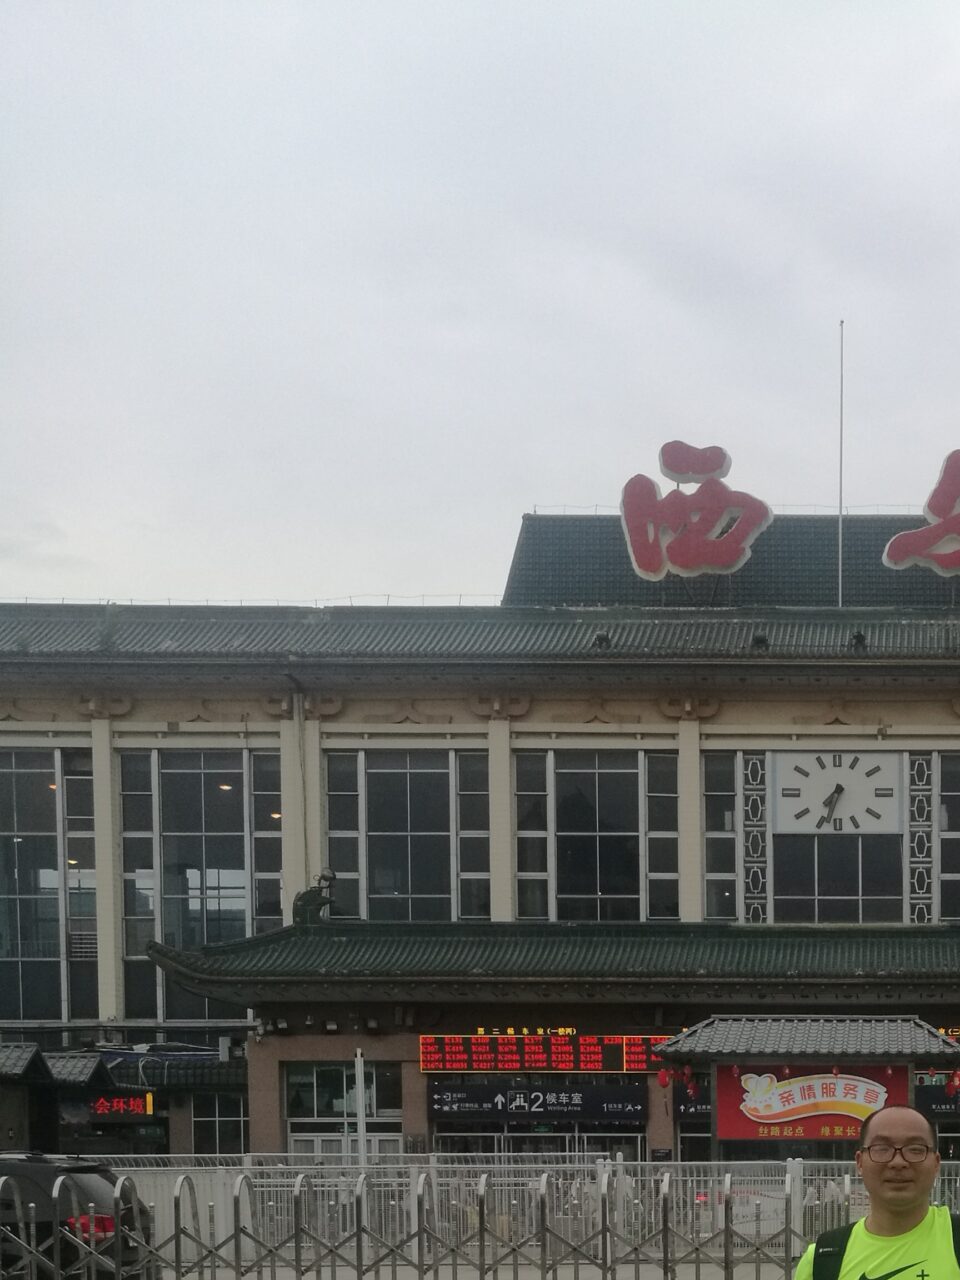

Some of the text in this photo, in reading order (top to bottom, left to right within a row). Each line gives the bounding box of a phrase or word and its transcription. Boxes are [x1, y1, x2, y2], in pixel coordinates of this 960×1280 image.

[530, 1092, 583, 1112] 2 候车室
[779, 1082, 881, 1107] 亲情服务亭
[90, 1097, 145, 1114] 会环境
[758, 1125, 862, 1138] 丝路起点 缘聚长
